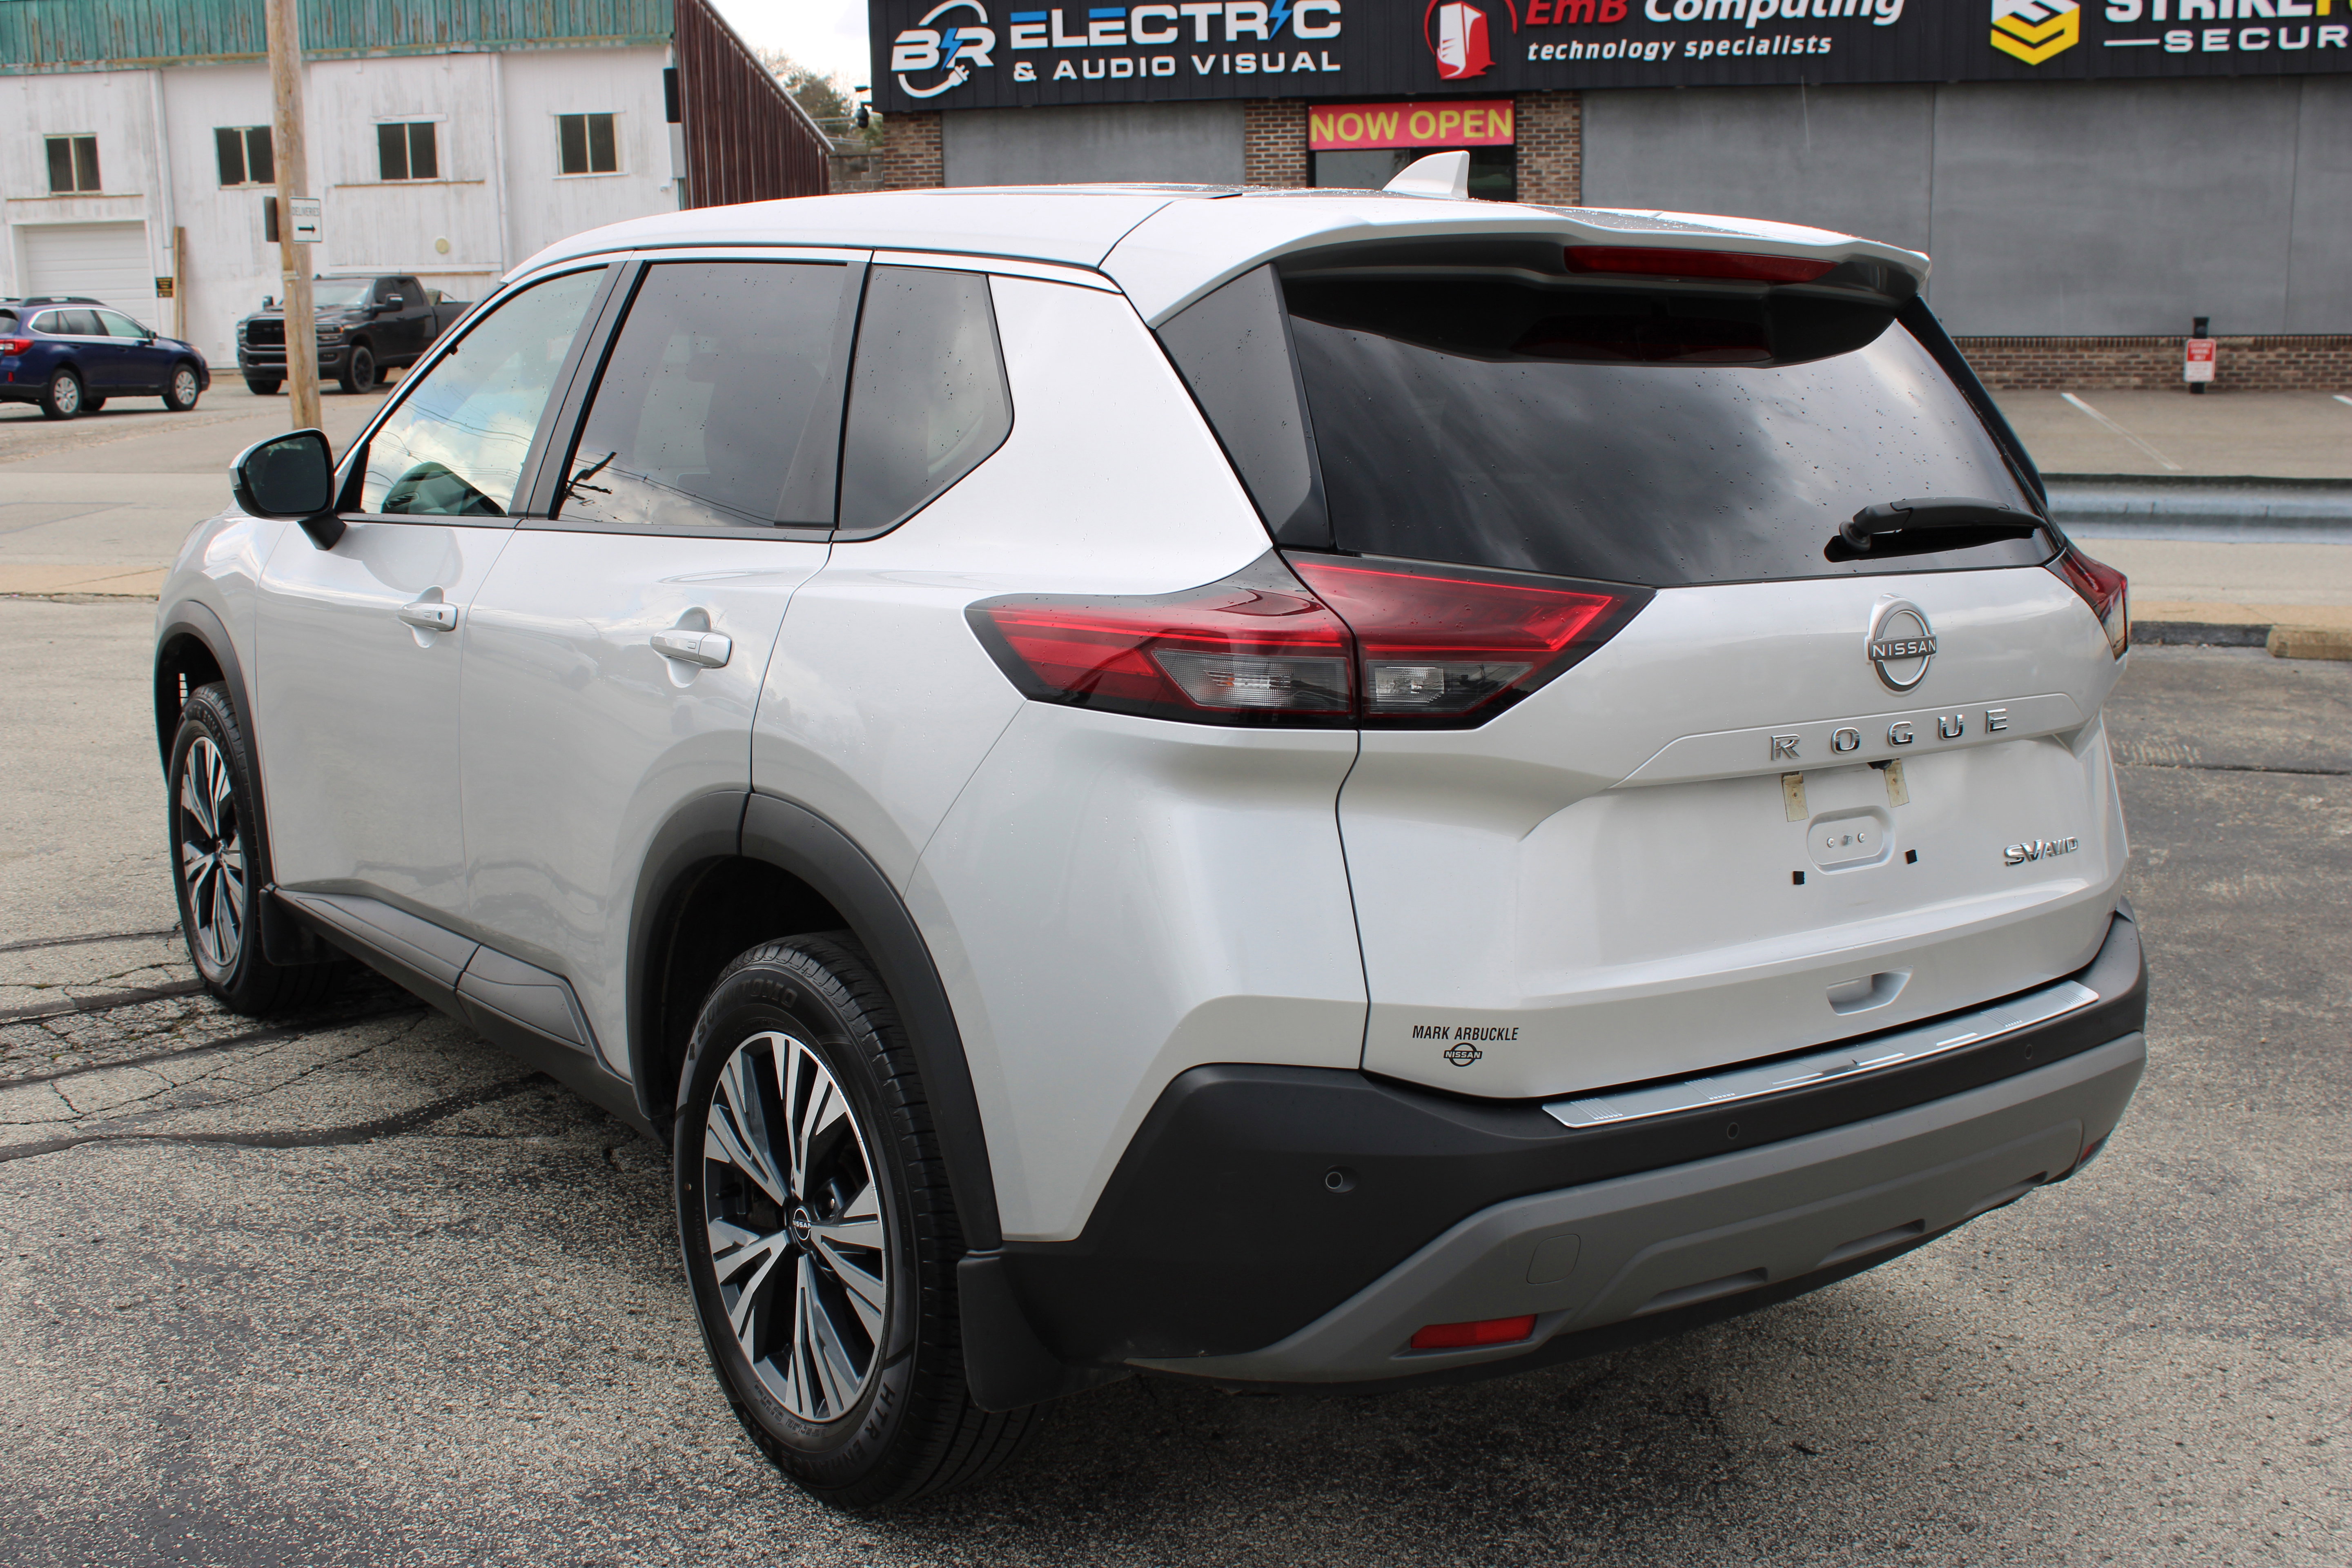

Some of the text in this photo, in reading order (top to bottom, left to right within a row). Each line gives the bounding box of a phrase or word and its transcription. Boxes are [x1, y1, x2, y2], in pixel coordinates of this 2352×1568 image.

[1644, 0, 1905, 29] Computing
[1528, 35, 1832, 61] technology specialists
[2164, 25, 2349, 52] SECUR
[1013, 51, 1341, 82] & AUDIO VISUAL
[1311, 108, 1512, 143] NOW OPEN
[1872, 639, 1936, 657] NISSAN
[1771, 708, 2008, 761] ROGUE
[2004, 839, 2042, 866] SV
[1412, 1025, 1519, 1041] MARK ARBUCKLE
[864, 1381, 896, 1441] HTR
